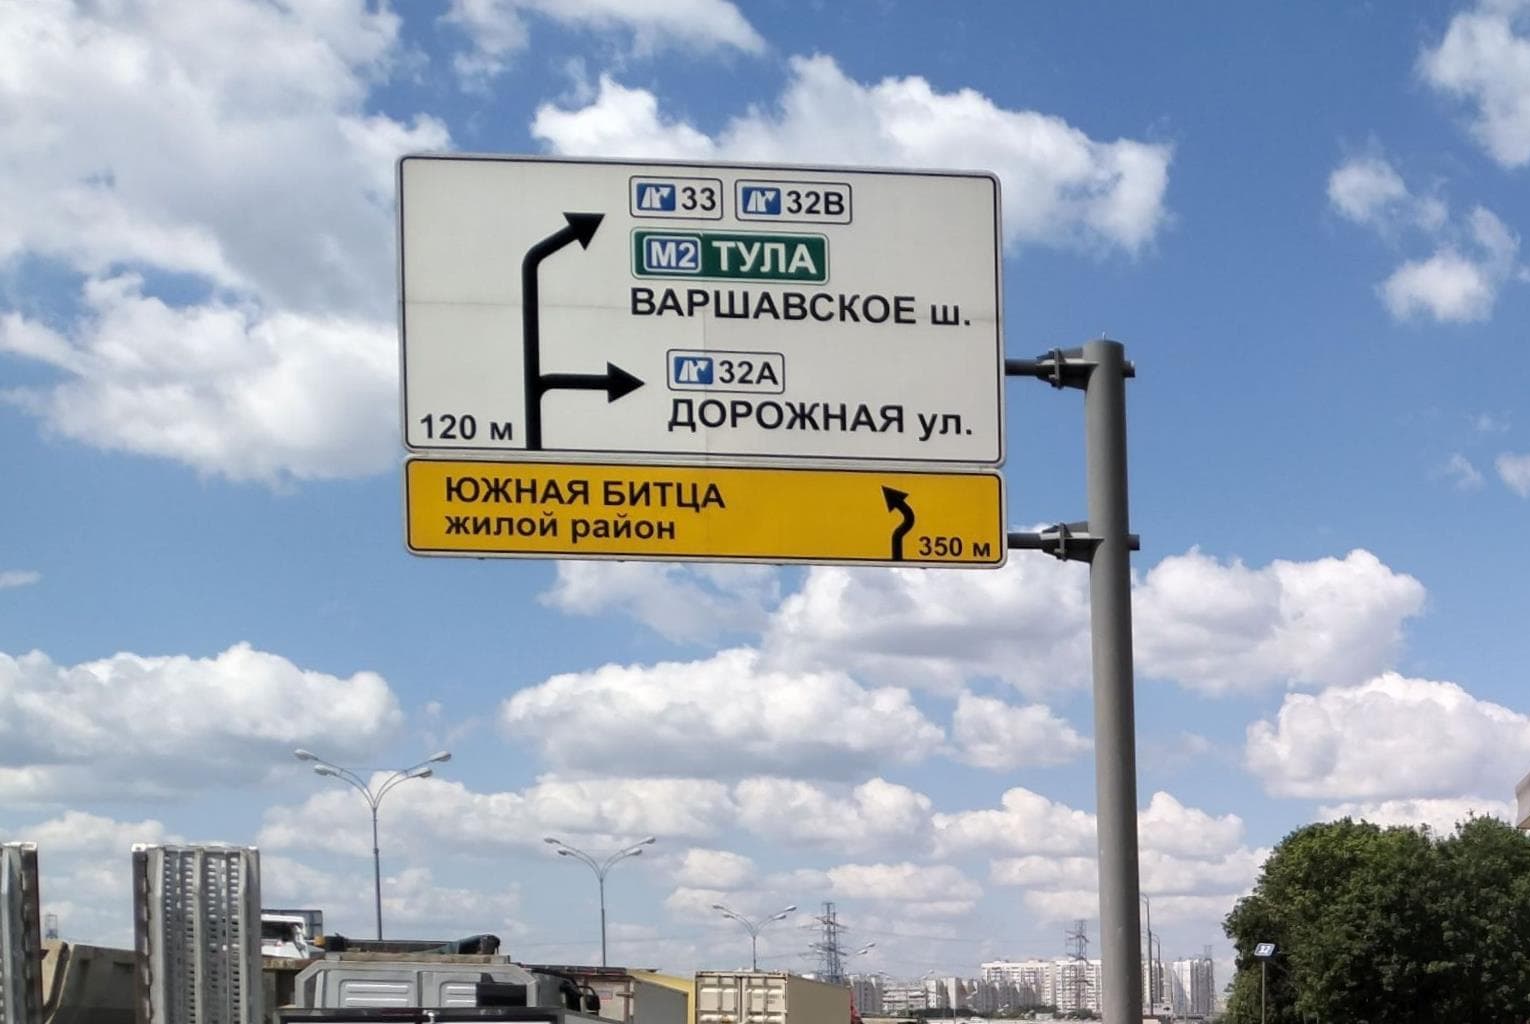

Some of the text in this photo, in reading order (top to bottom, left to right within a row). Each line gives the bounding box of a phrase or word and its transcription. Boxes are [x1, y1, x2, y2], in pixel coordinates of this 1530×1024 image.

[681, 186, 717, 212] 33
[712, 241, 817, 274] ТУЛА
[631, 287, 972, 327] ВАРШАВСКОЕ ш.
[420, 414, 513, 441] 120 м
[667, 398, 974, 442] ДОРОЖНАЯ ул.
[445, 476, 726, 510] ЮЖНАЯ БИТЦА
[445, 512, 676, 543] жилой район
[918, 537, 991, 558] 350 м
